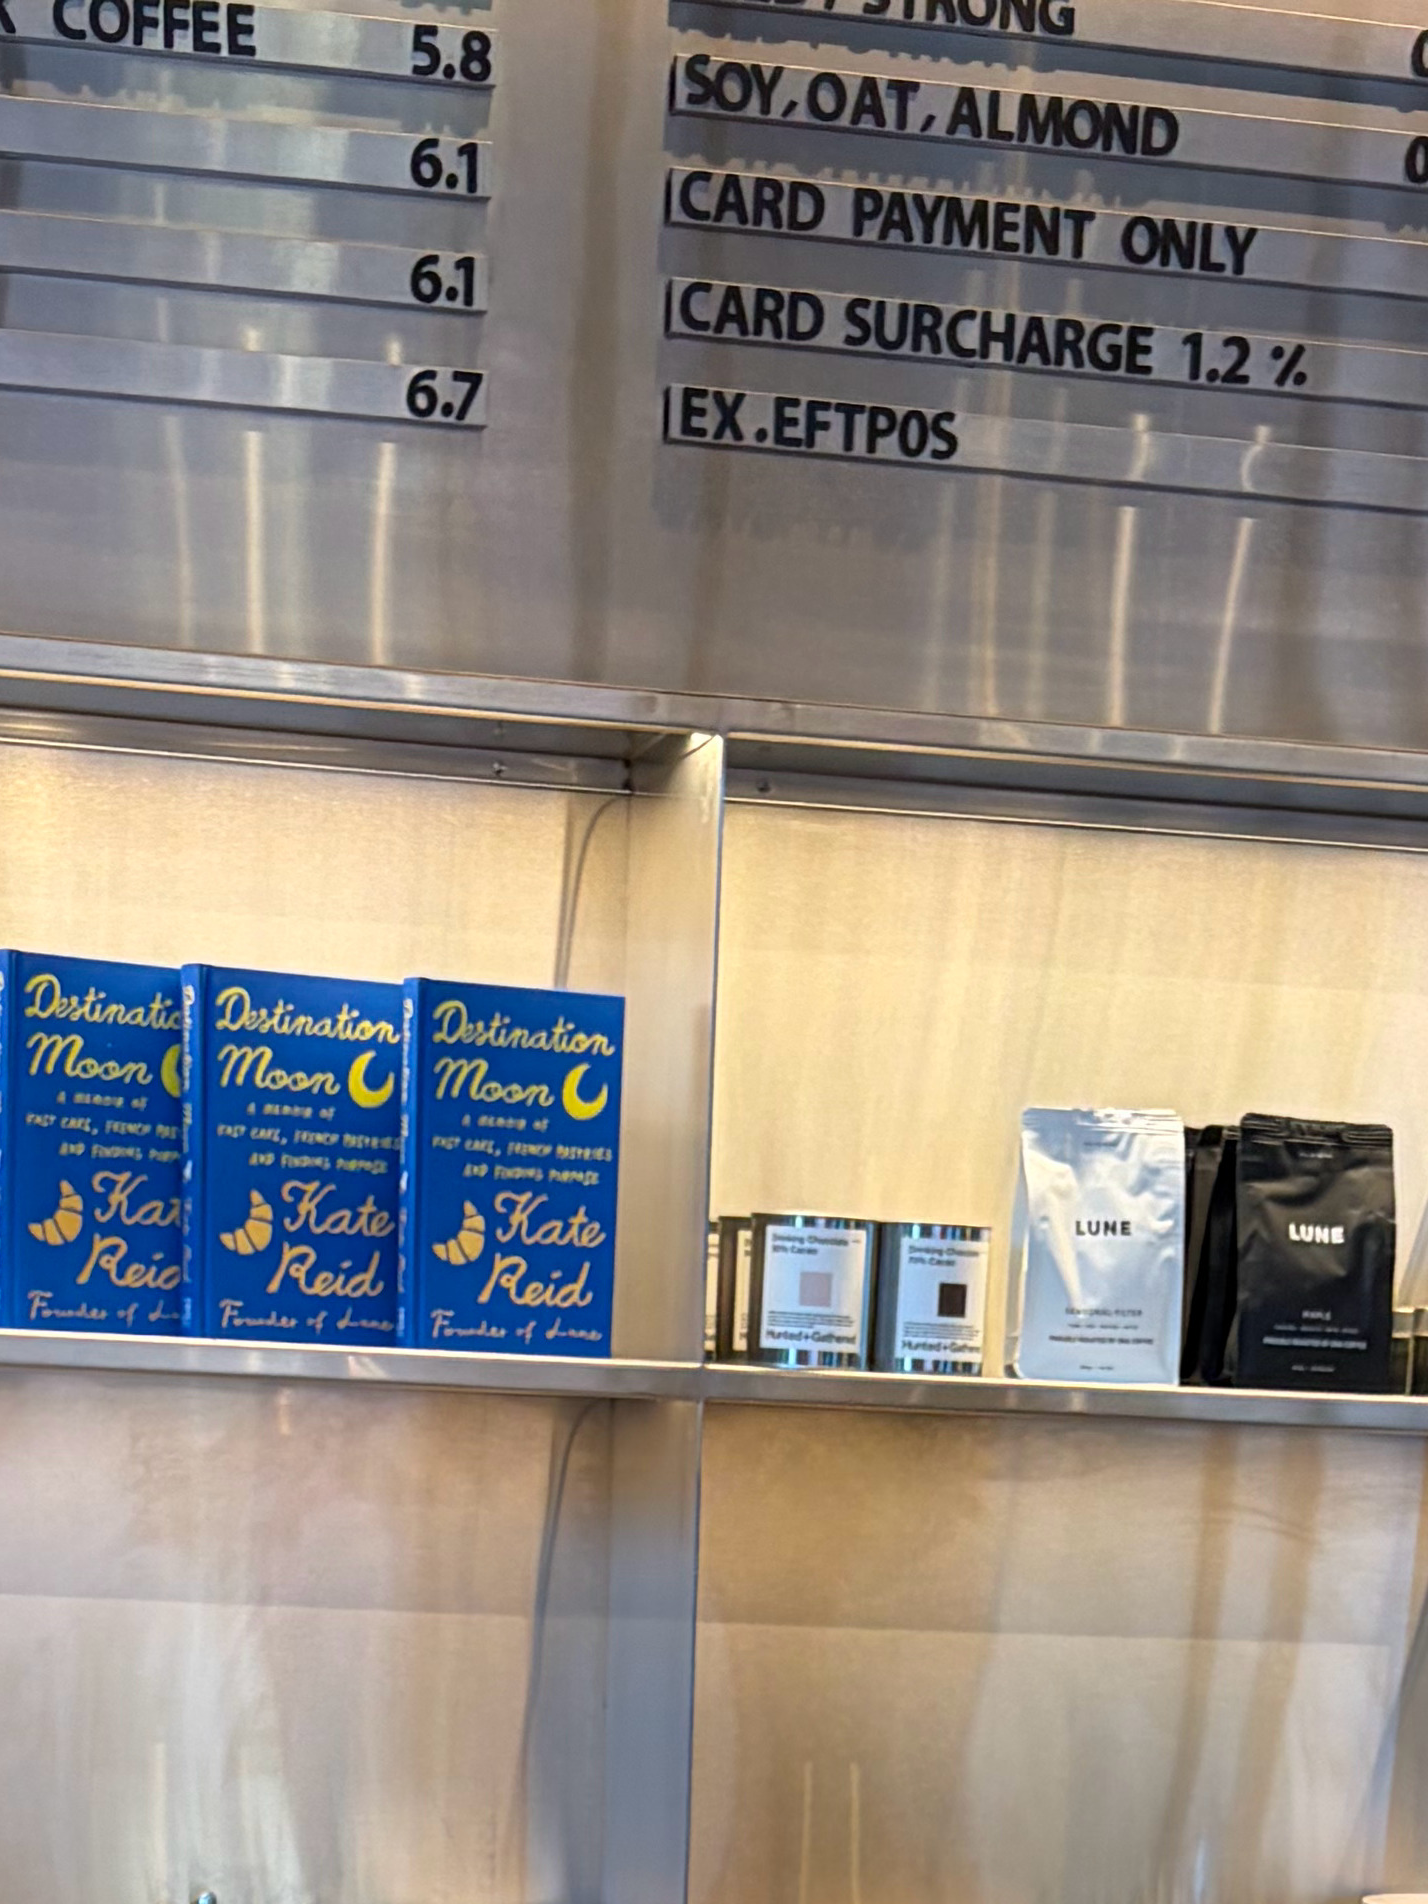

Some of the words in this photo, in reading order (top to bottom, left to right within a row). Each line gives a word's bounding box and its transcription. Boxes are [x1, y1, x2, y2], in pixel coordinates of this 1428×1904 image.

[411, 25, 493, 82] 5.8
[410, 139, 479, 194] 6.1
[680, 172, 825, 229] CARD
[852, 188, 1096, 261] PAYMENT
[1122, 216, 1258, 277] ONLY
[410, 254, 476, 306] 6.1
[680, 282, 824, 342] CARD
[844, 299, 1153, 376] SURCHARGE
[406, 371, 483, 422] 6.7
[215, 986, 401, 1044] Destination
[432, 1000, 616, 1057] Destination
[27, 1032, 153, 1085] Moon
[217, 1045, 341, 1095] Moon
[433, 1057, 555, 1107] Moon
[281, 1180, 394, 1238] Kate
[494, 1190, 607, 1249] Kate
[1075, 1220, 1132, 1236] LUNE
[1289, 1223, 1345, 1244] LUNE
[266, 1241, 383, 1298] Reid
[478, 1252, 593, 1308] Reid
